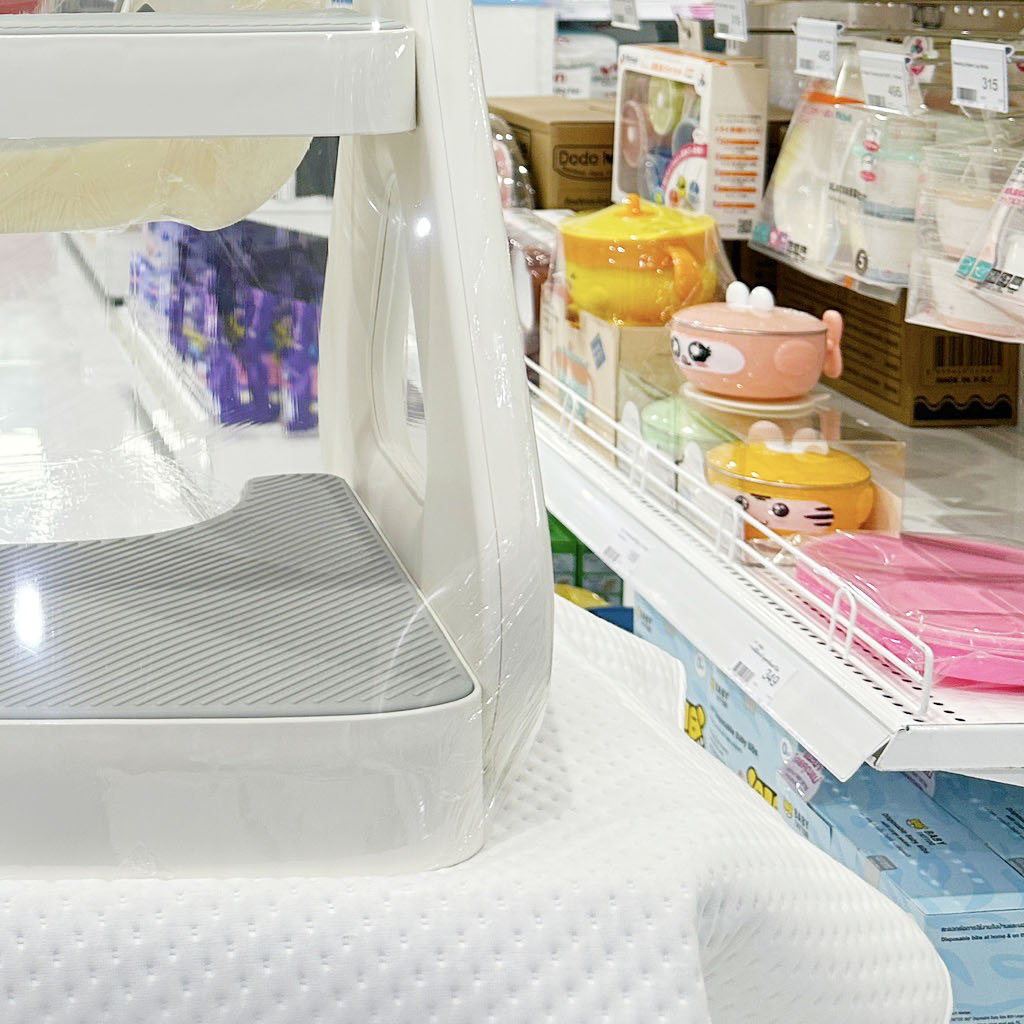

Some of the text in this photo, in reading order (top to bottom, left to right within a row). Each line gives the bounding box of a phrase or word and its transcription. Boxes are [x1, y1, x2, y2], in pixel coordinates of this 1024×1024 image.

[982, 77, 998, 91] 315
[559, 150, 598, 166] Dodo
[924, 830, 947, 845] BABY
